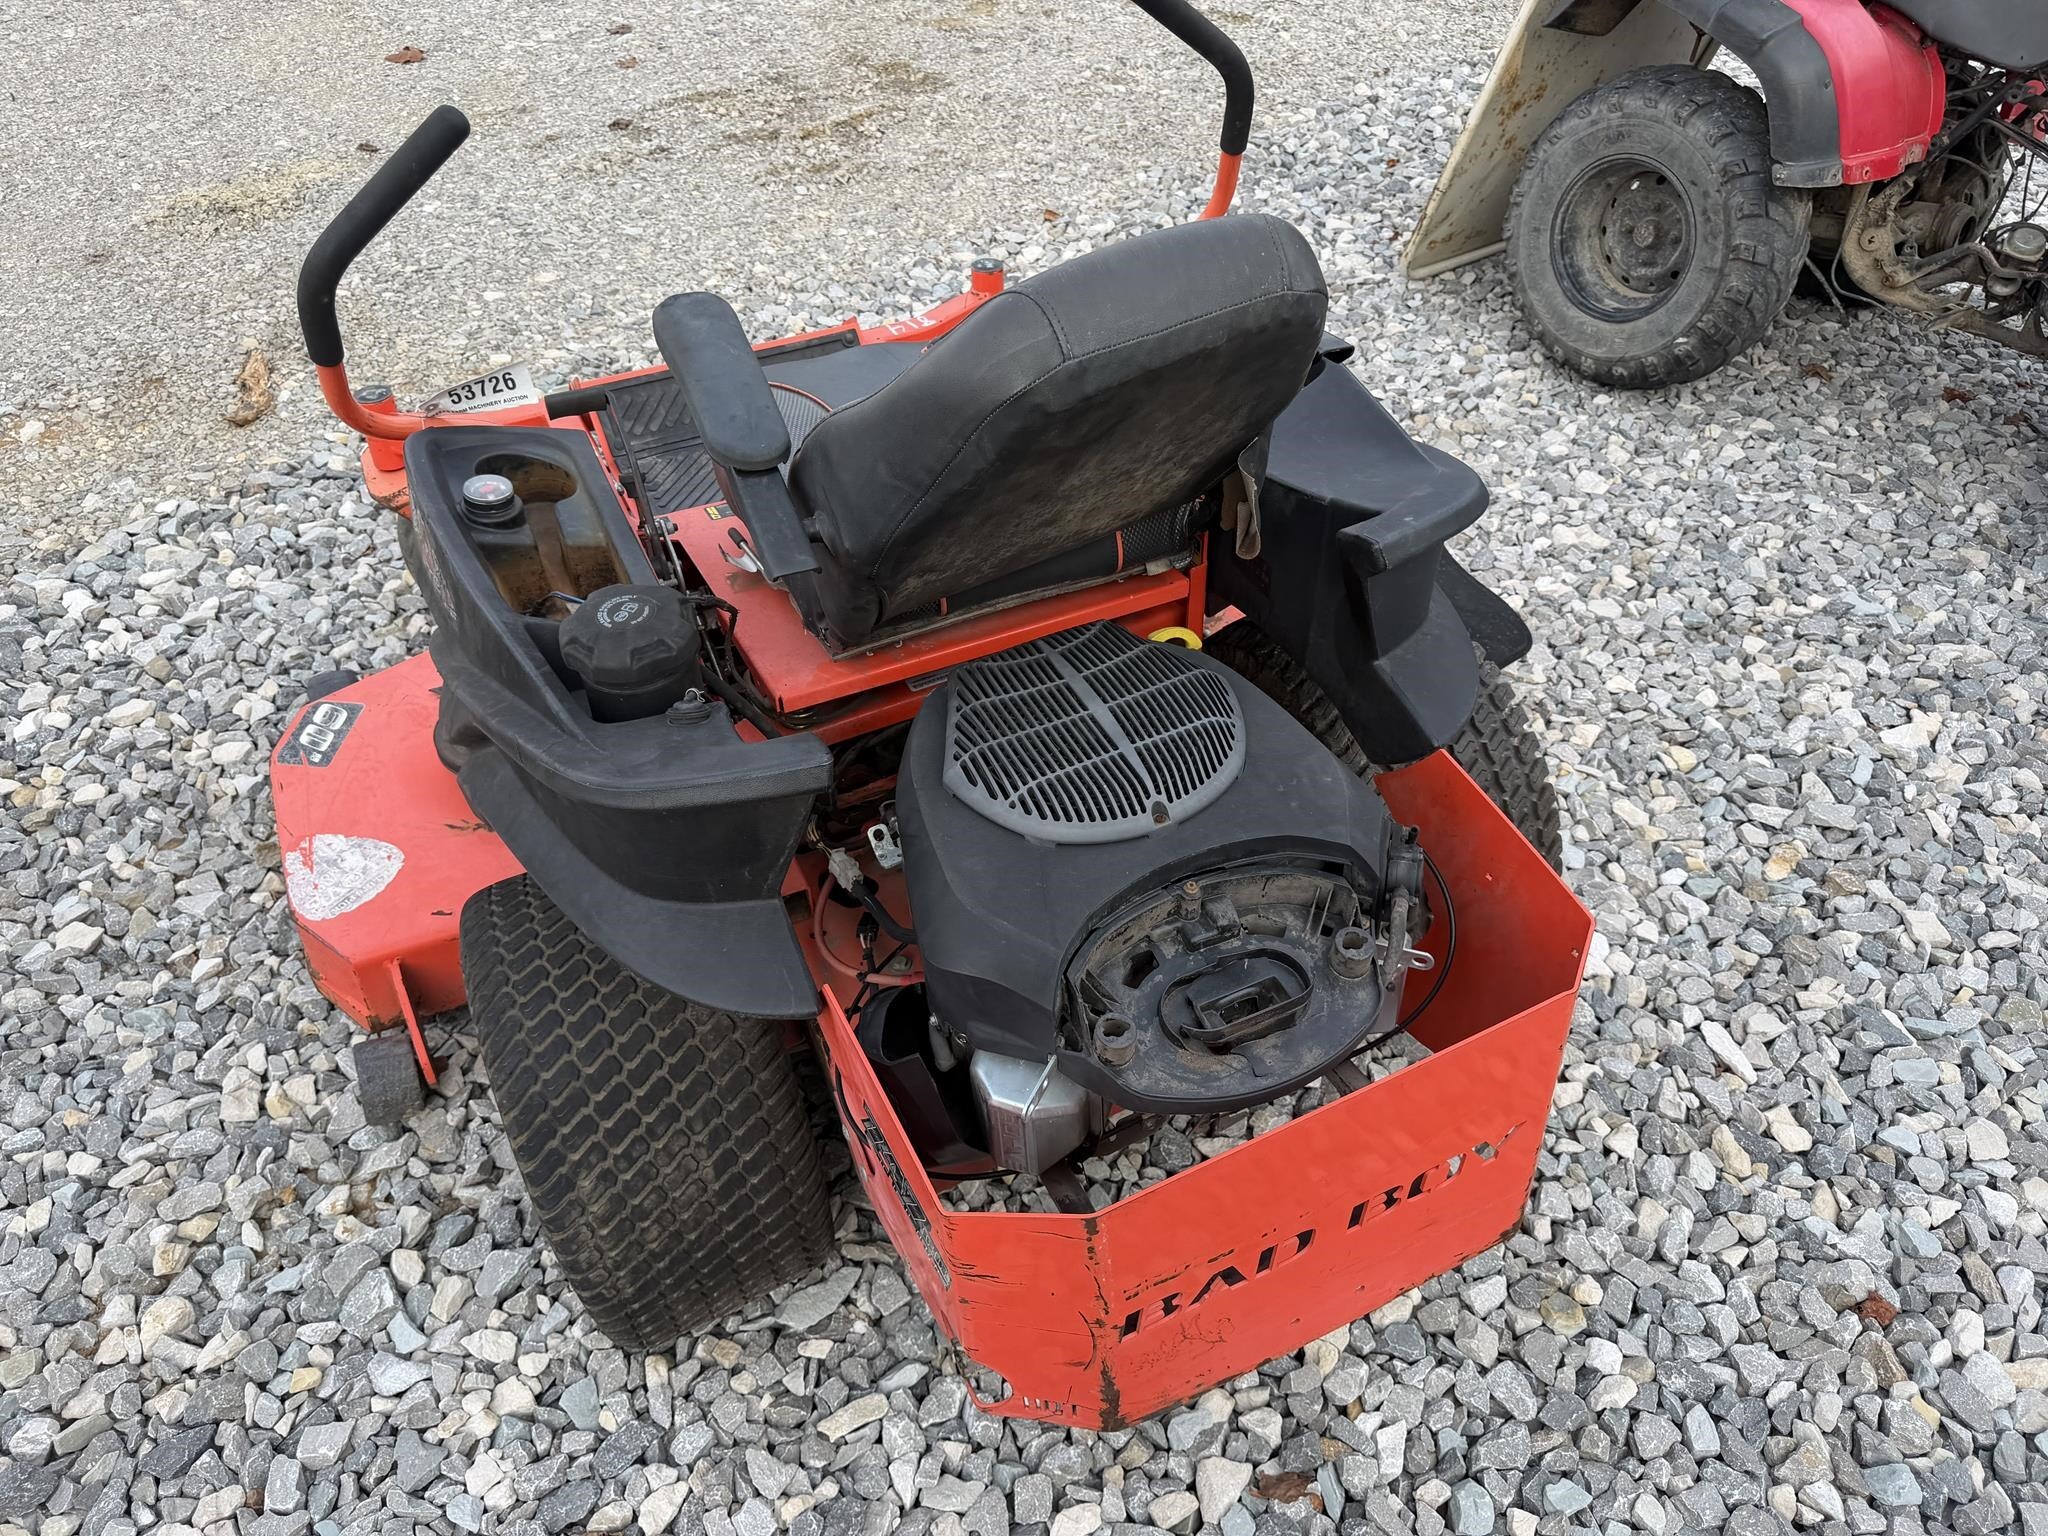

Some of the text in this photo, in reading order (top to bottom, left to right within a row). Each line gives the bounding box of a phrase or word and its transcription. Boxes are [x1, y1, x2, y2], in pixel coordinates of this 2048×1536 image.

[448, 371, 516, 404] 53726
[468, 399, 502, 411] MACHINERY
[503, 394, 529, 404] AUCTION
[1120, 1120, 1527, 1343] BAD BOY
